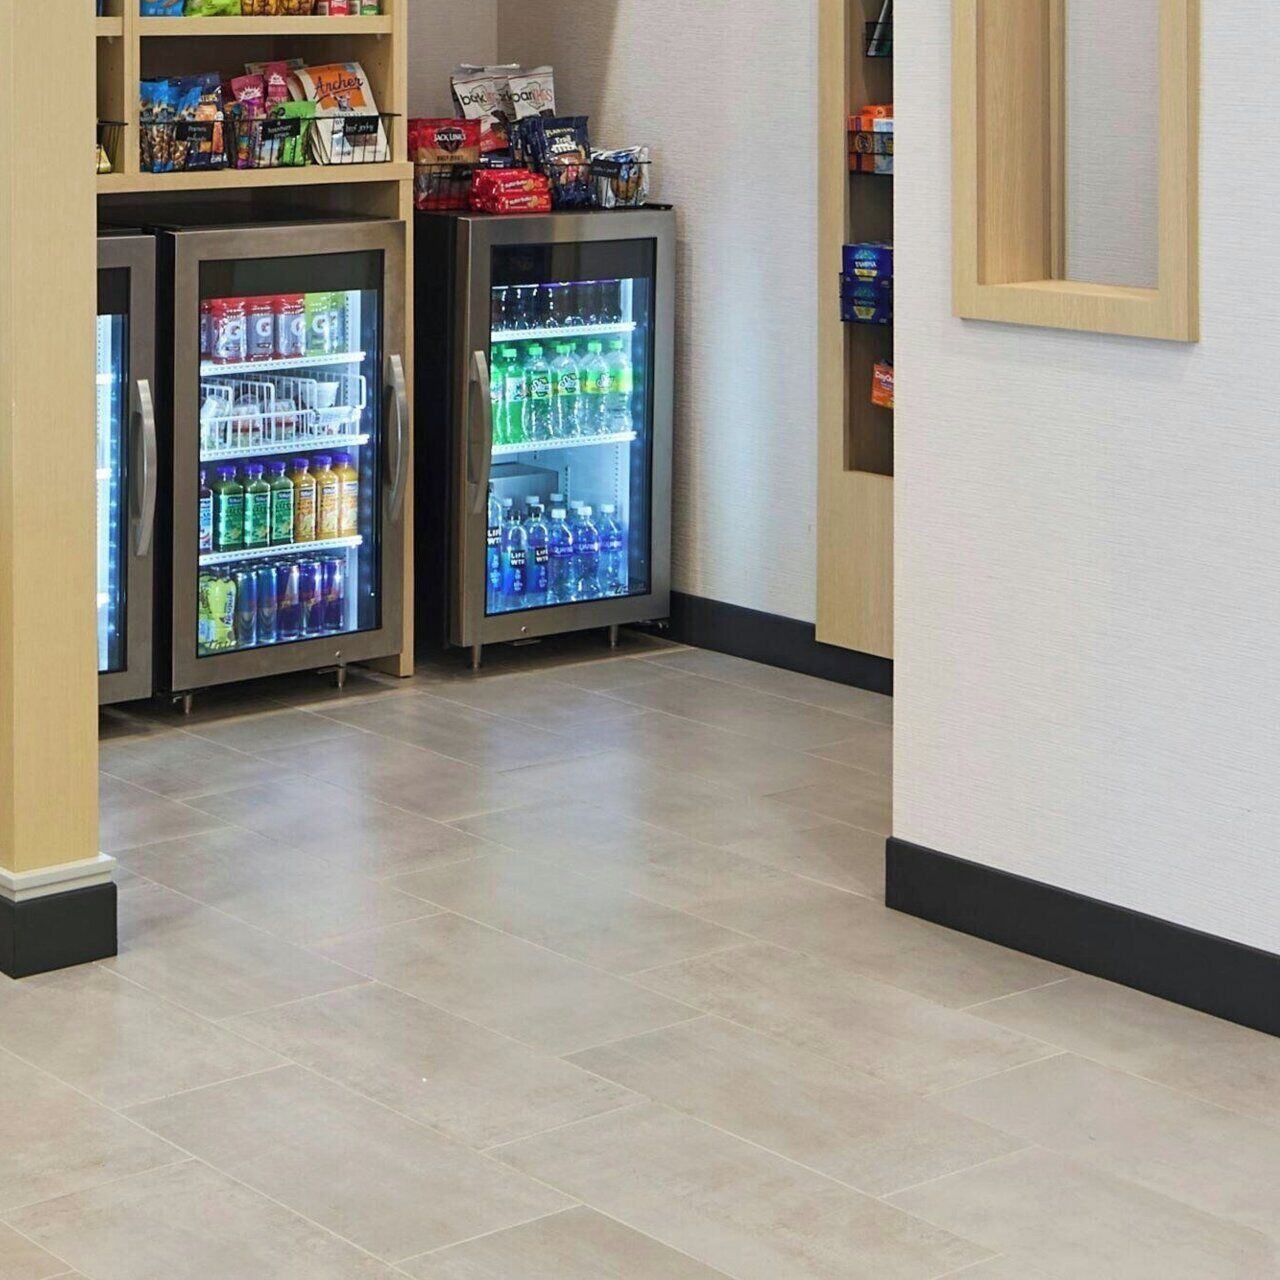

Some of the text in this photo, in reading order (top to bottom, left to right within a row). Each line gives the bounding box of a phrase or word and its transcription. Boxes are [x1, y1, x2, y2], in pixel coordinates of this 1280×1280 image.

[313, 73, 364, 100] Archer
[256, 317, 271, 337] G
[312, 315, 327, 334] G
